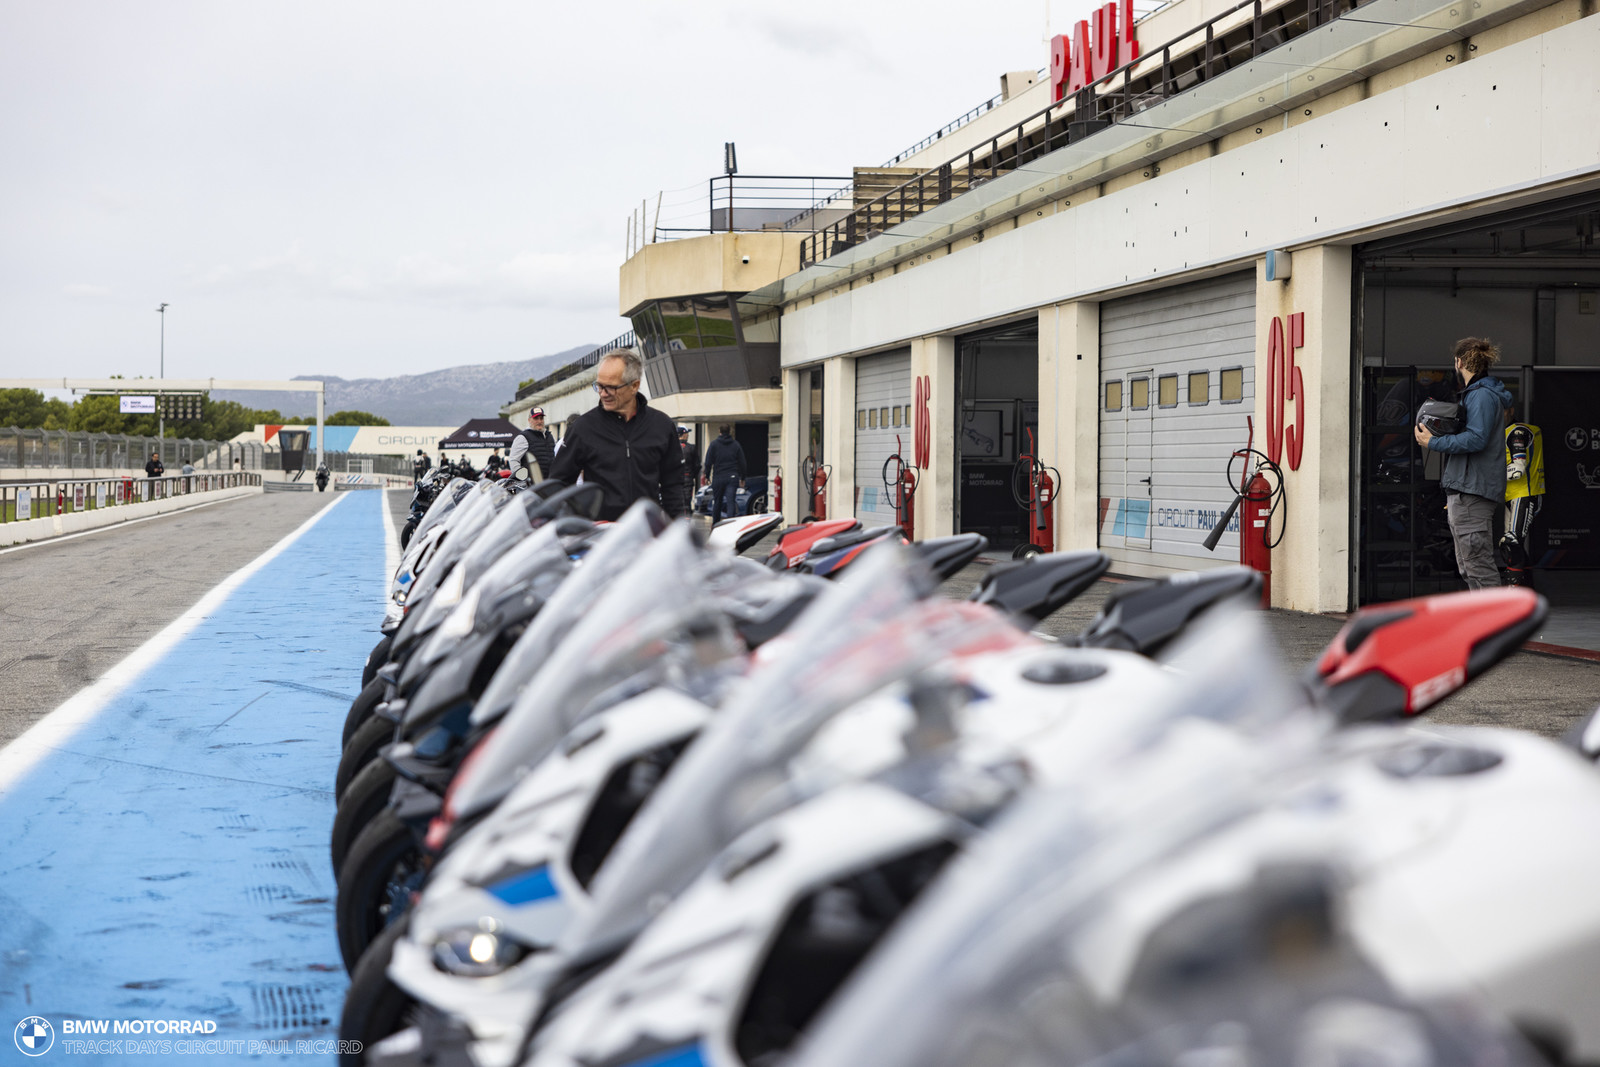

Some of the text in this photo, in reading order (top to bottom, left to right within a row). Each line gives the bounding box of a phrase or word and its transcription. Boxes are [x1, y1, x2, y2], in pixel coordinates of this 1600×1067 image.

[1051, 0, 1139, 107] PAUL
[915, 375, 931, 470] 06
[1266, 311, 1305, 472] 05
[378, 435, 438, 445] CIRCUIT
[1158, 508, 1195, 528] CIRCUIT
